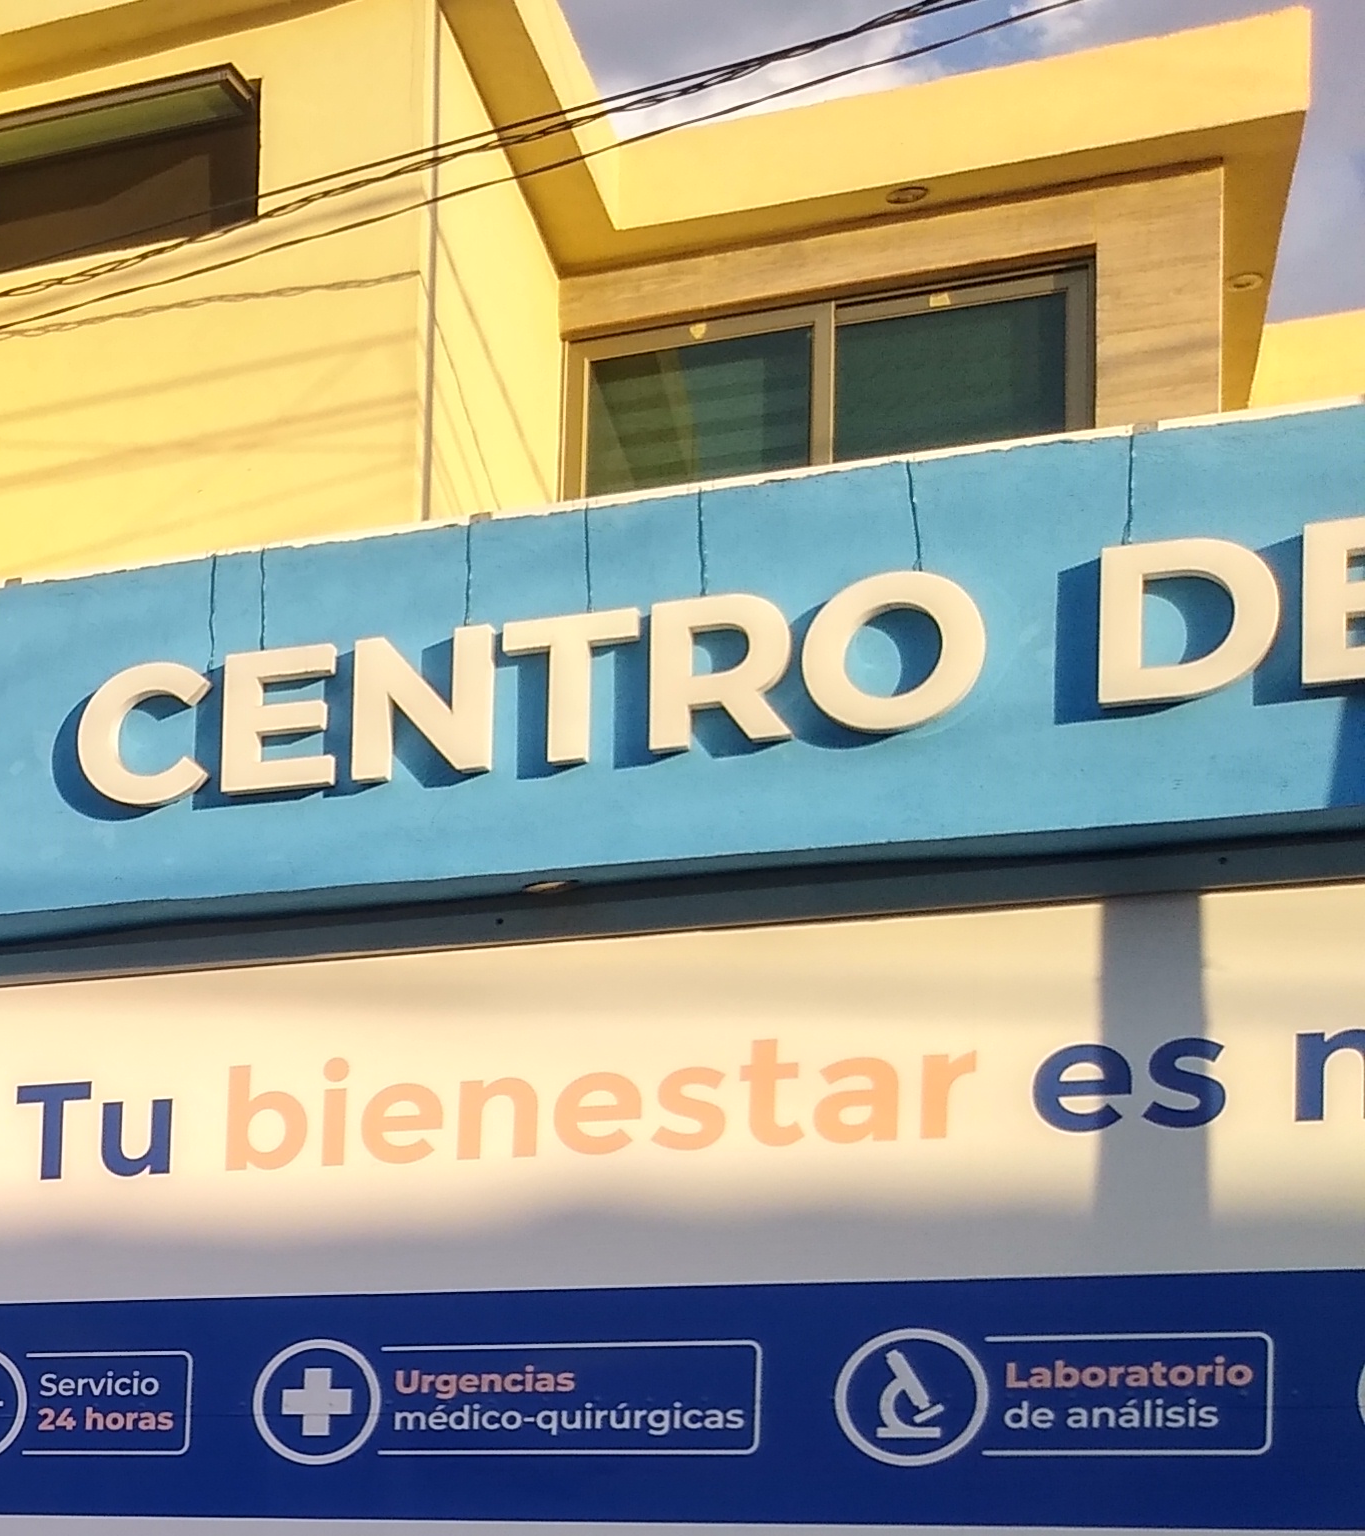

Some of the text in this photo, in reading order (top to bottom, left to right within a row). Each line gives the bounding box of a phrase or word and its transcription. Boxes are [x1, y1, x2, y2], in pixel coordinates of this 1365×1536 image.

[76, 570, 987, 808] CENTRO
[16, 1080, 174, 1181] Tu
[225, 1039, 978, 1171] bienestar
[1033, 1036, 1227, 1132] es
[39, 1371, 160, 1398] Servicio
[394, 1364, 576, 1402] Urgencias
[1004, 1358, 1253, 1389] Laboratorio
[37, 1407, 174, 1432] 24 horas
[393, 1401, 745, 1438] médico-quirúrgicas
[1003, 1398, 1219, 1431] de análisis
